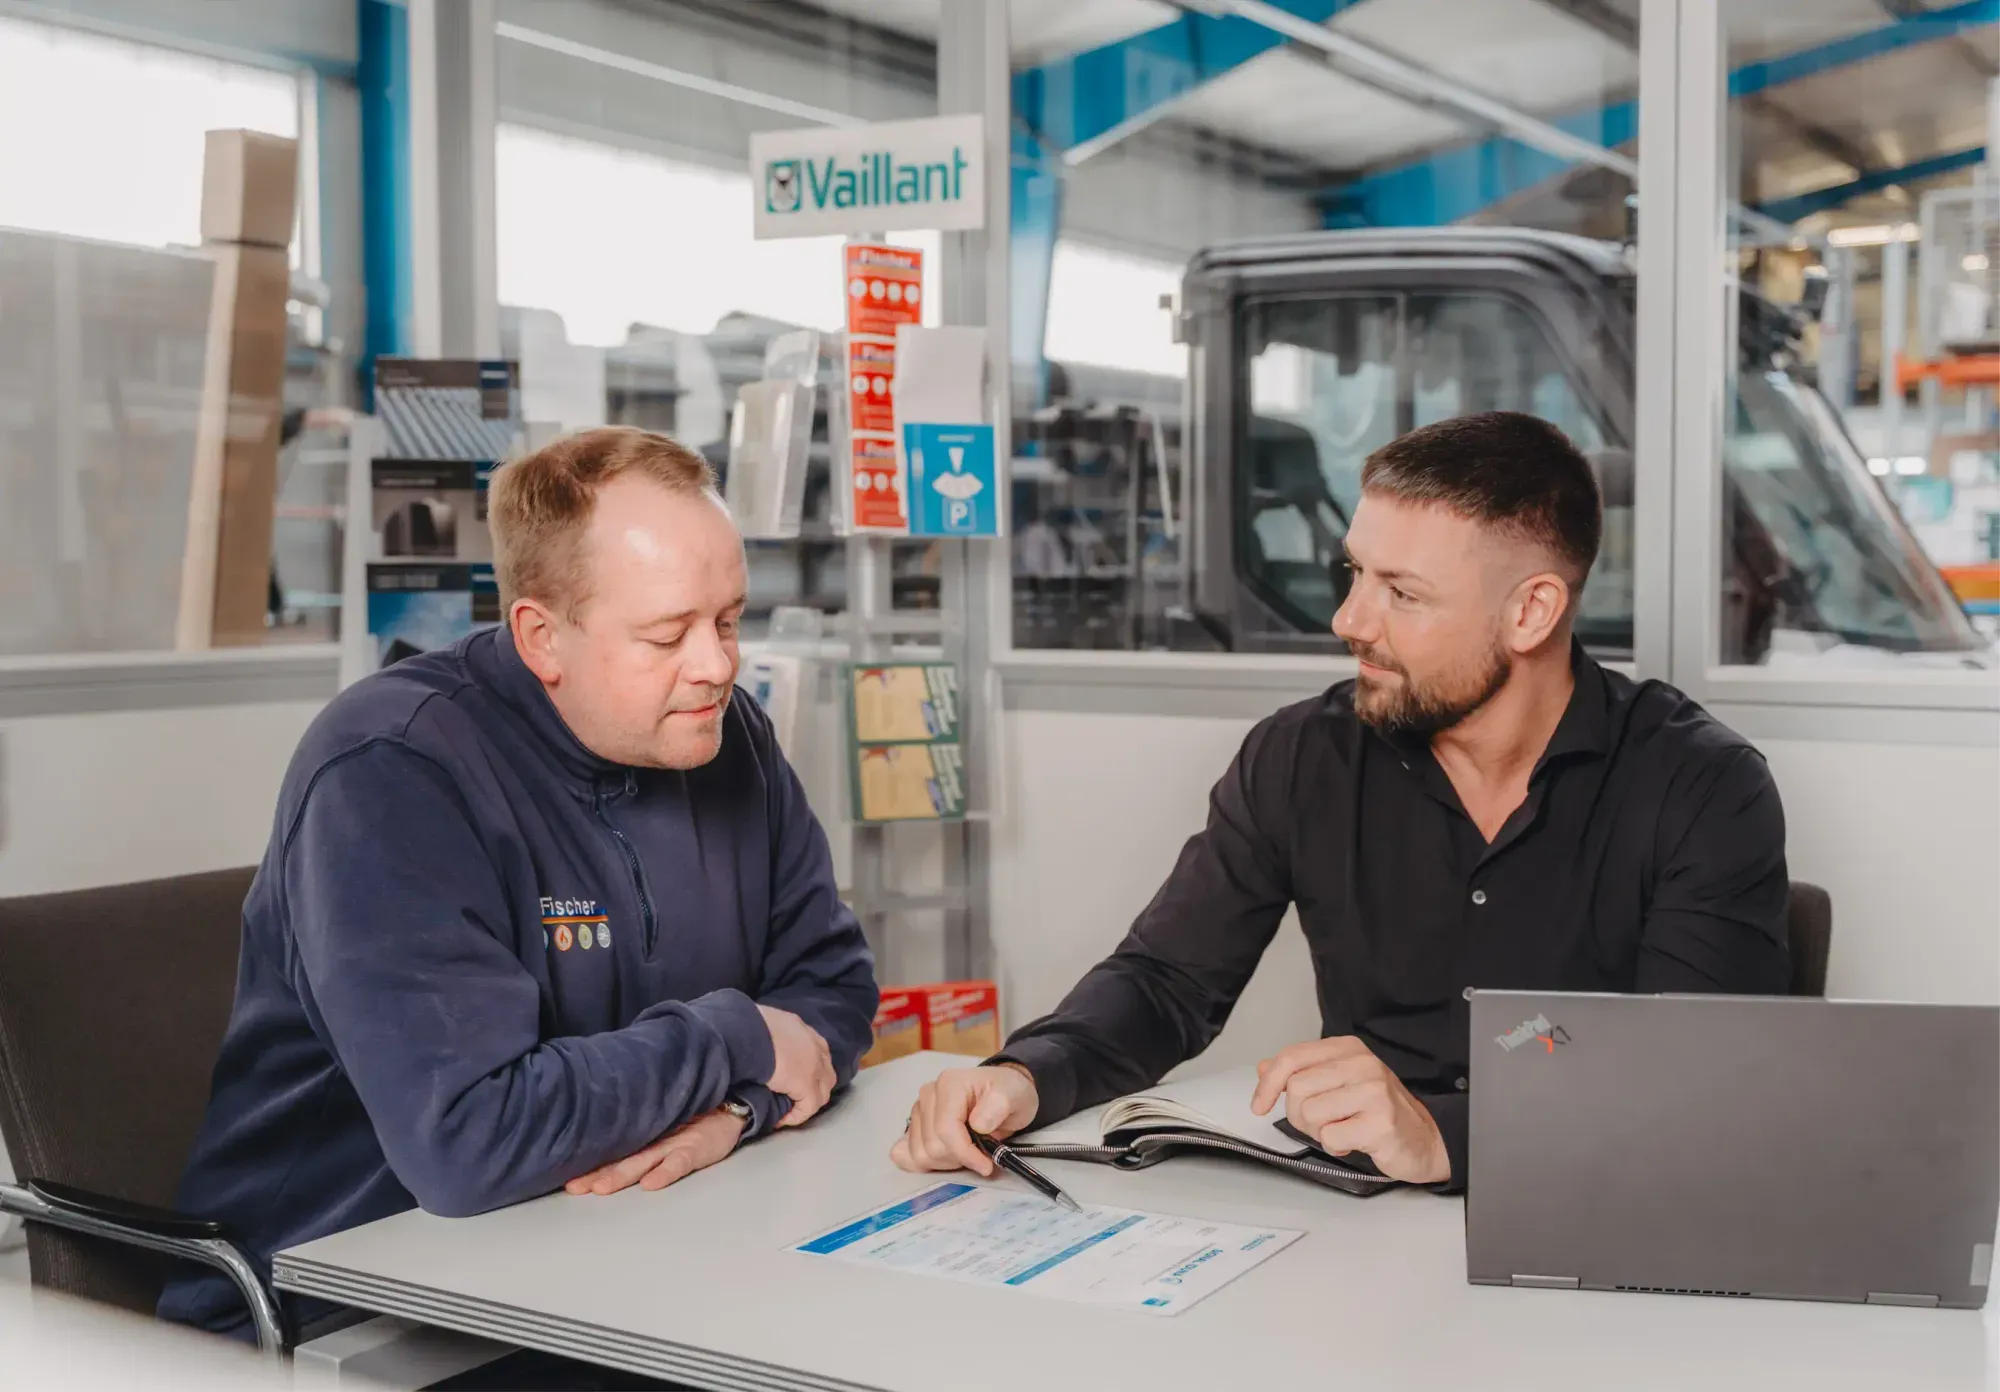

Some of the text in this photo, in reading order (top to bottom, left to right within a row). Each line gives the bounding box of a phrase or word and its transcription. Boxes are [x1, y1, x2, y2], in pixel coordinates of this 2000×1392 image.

[806, 146, 968, 210] Vaillant
[951, 501, 968, 528] P
[539, 896, 596, 916] Fischer
